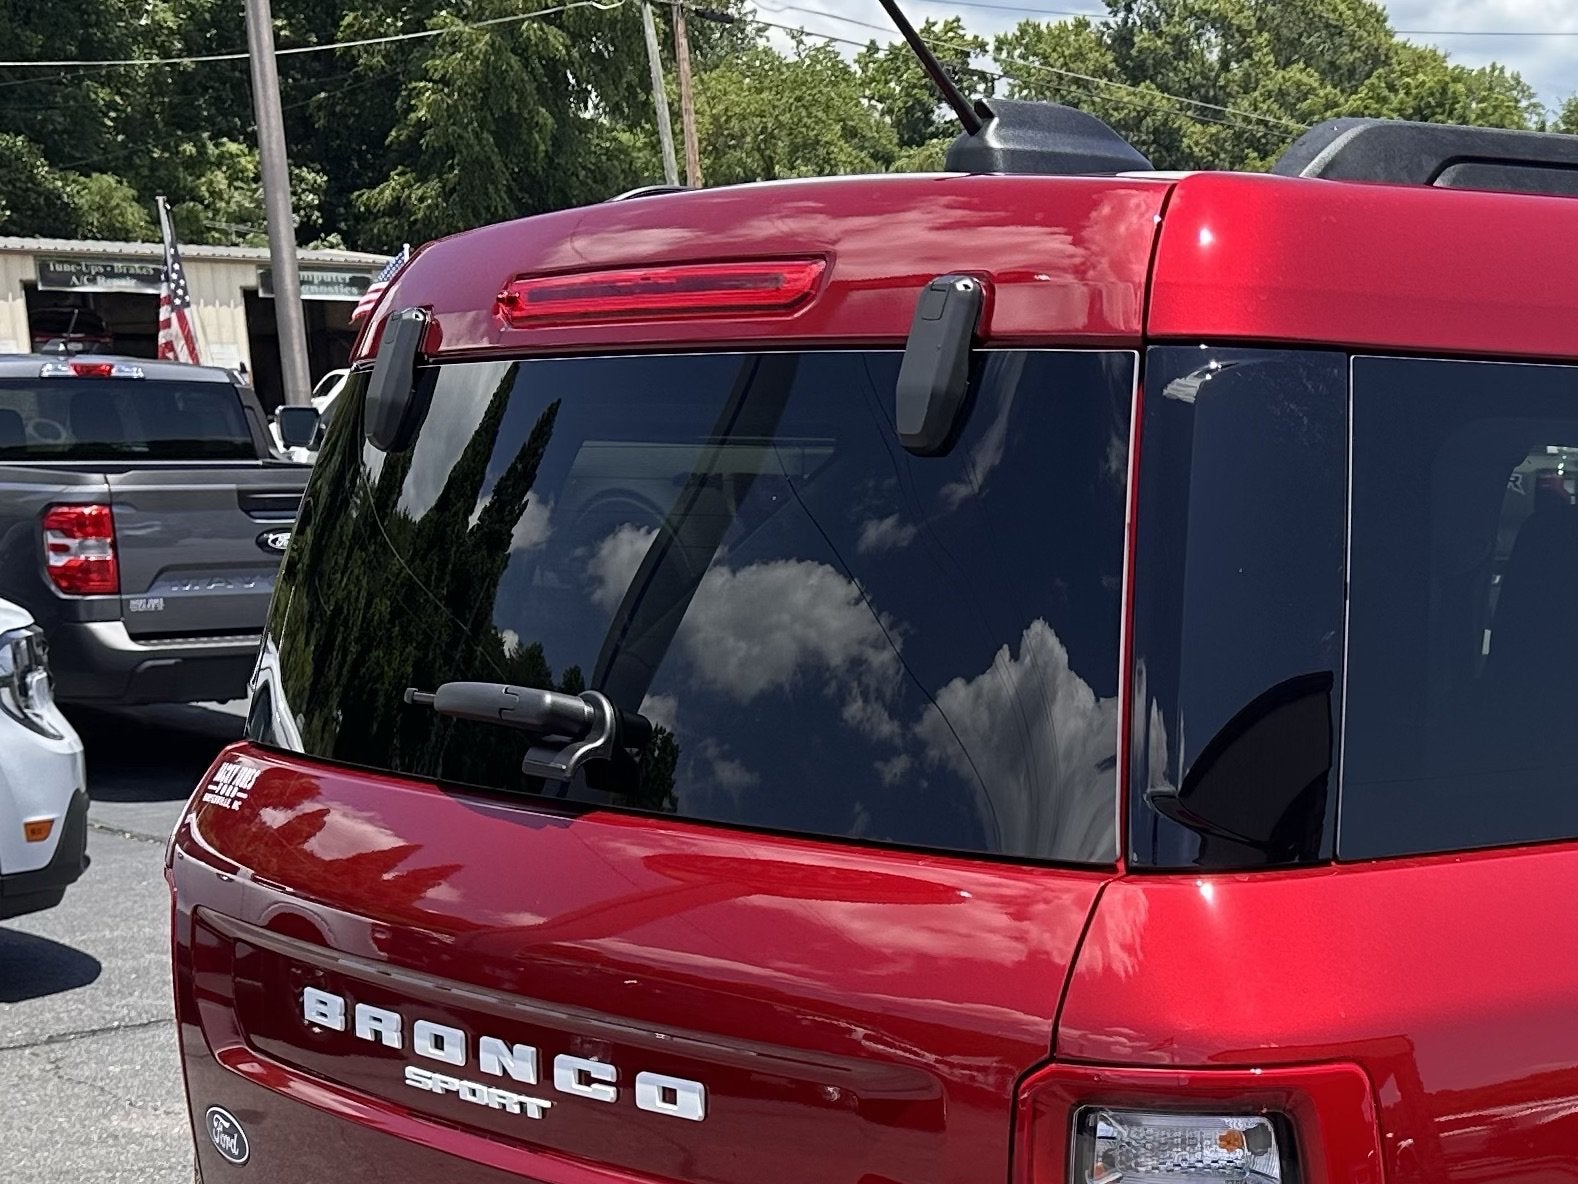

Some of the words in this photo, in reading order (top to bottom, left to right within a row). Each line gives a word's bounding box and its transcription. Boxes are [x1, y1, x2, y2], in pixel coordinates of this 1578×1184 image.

[301, 273, 350, 284] mputer
[301, 284, 359, 296] gnostics
[303, 986, 707, 1122] BRONCO
[404, 1065, 555, 1120] SPORT
